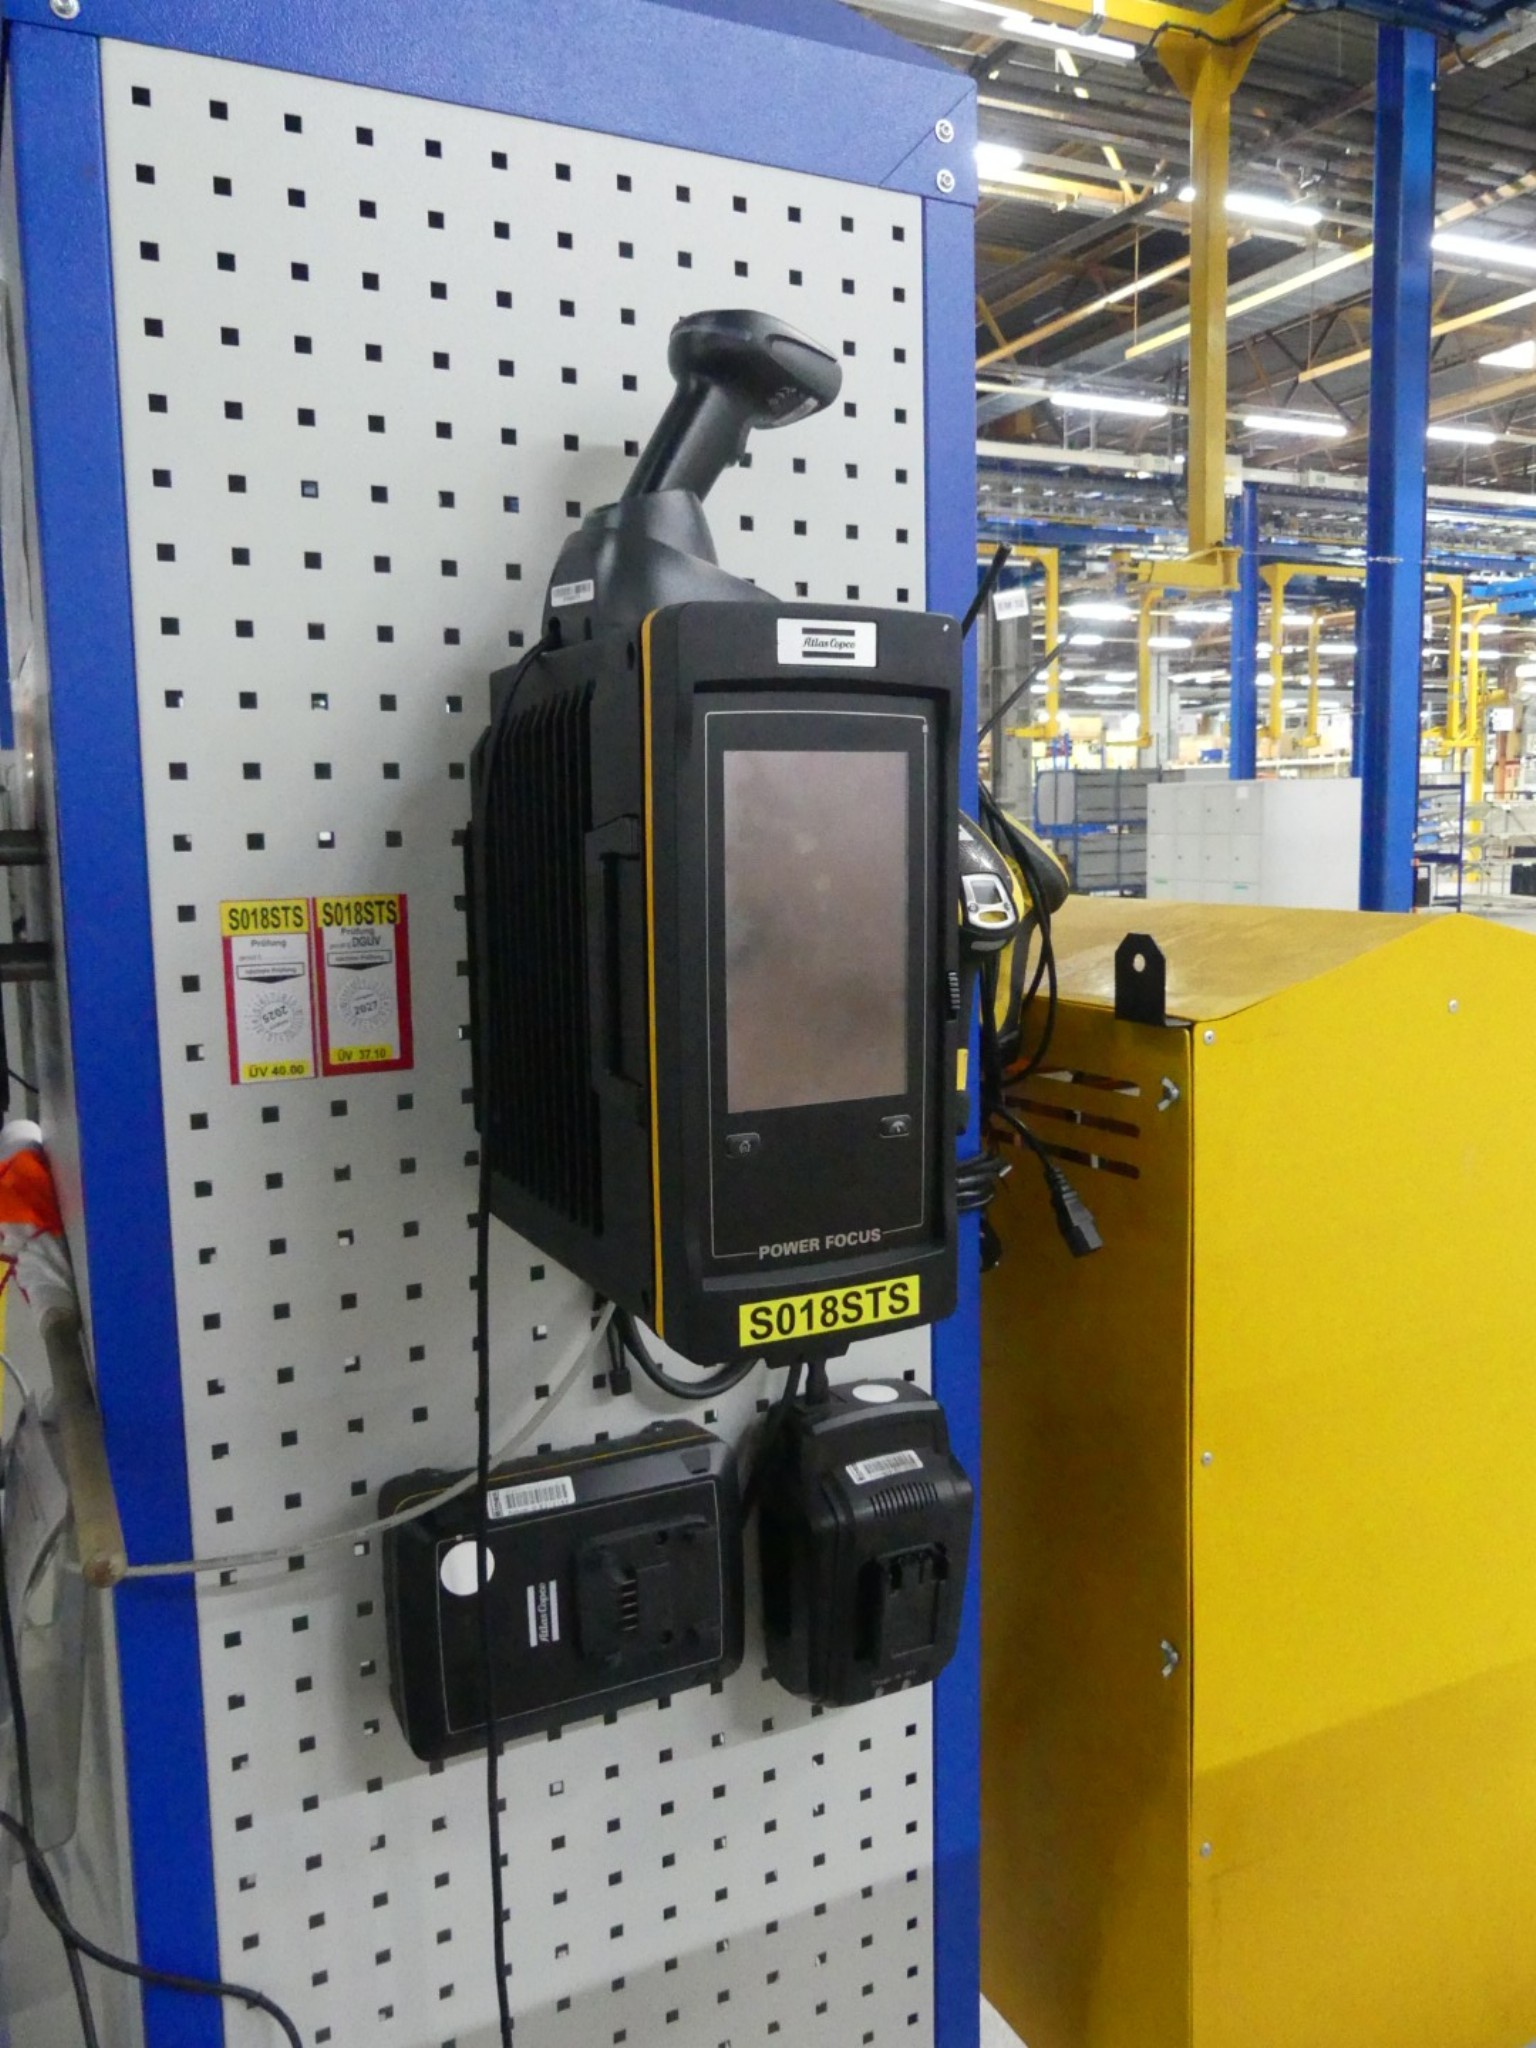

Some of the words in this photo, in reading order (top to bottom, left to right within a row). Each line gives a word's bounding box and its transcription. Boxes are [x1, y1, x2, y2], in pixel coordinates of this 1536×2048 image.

[803, 636, 829, 648] Atlas
[830, 638, 856, 650] Copco
[228, 905, 304, 931] S018STS
[322, 900, 397, 927] S018STS
[250, 939, 287, 949] Prüfung
[352, 935, 382, 948] DGUV
[262, 1004, 289, 1024] 2025
[359, 1048, 387, 1059] 37.10
[272, 1064, 305, 1075] 40.00
[758, 1237, 820, 1260] POWER
[825, 1228, 882, 1249] FOCUS
[749, 1282, 910, 1340] S018STS
[537, 1582, 549, 1613] Copco
[538, 1613, 550, 1642] Atlas
